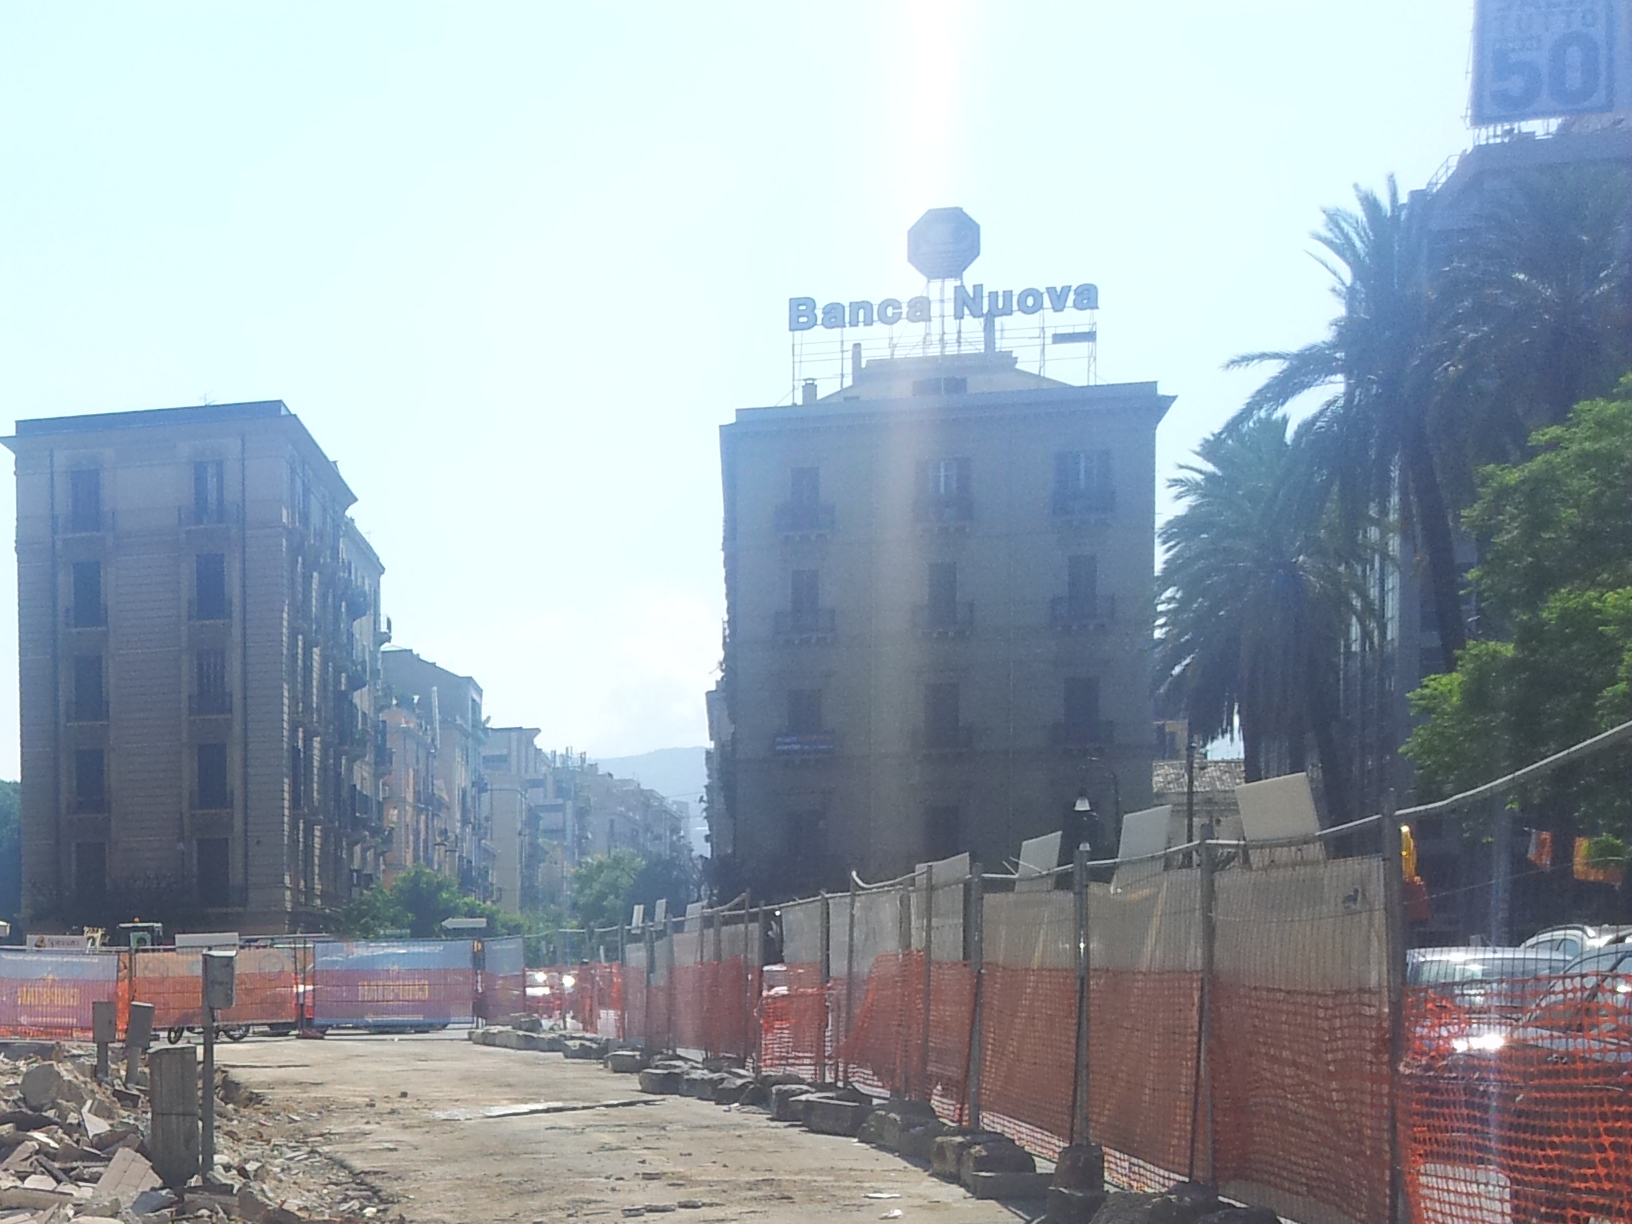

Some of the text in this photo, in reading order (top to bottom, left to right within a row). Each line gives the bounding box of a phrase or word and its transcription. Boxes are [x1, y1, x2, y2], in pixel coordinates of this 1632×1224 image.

[1490, 30, 1600, 111] 50
[788, 283, 1100, 332] Banca Nuova
